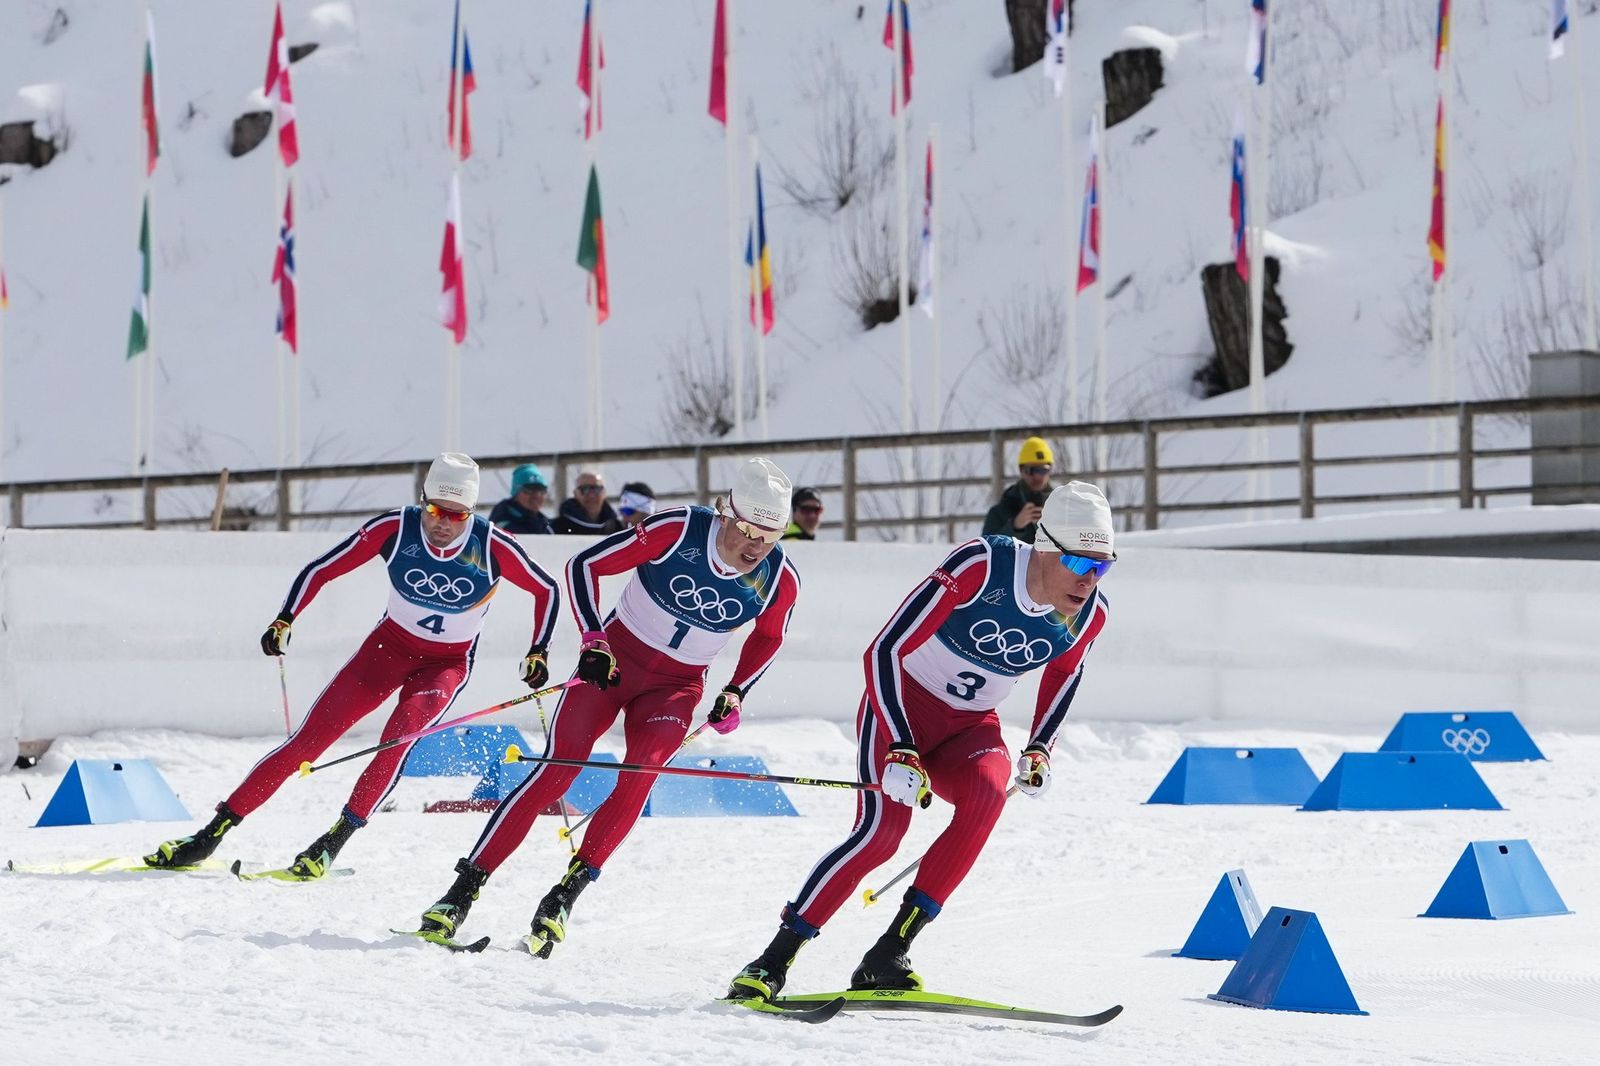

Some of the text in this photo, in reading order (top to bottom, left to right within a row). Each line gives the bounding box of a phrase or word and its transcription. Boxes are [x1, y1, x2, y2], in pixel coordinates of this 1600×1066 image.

[439, 485, 463, 493] NORGE
[753, 507, 781, 519] NORGE
[929, 570, 953, 586] RAFT
[654, 592, 715, 631] MILANO CORTINA
[416, 614, 445, 635] 4
[668, 620, 691, 650] 1
[947, 635, 1015, 674] MILANO CORTINA
[946, 671, 986, 701] 3
[647, 715, 681, 724] CRAFT
[871, 990, 905, 998] FISCHER
